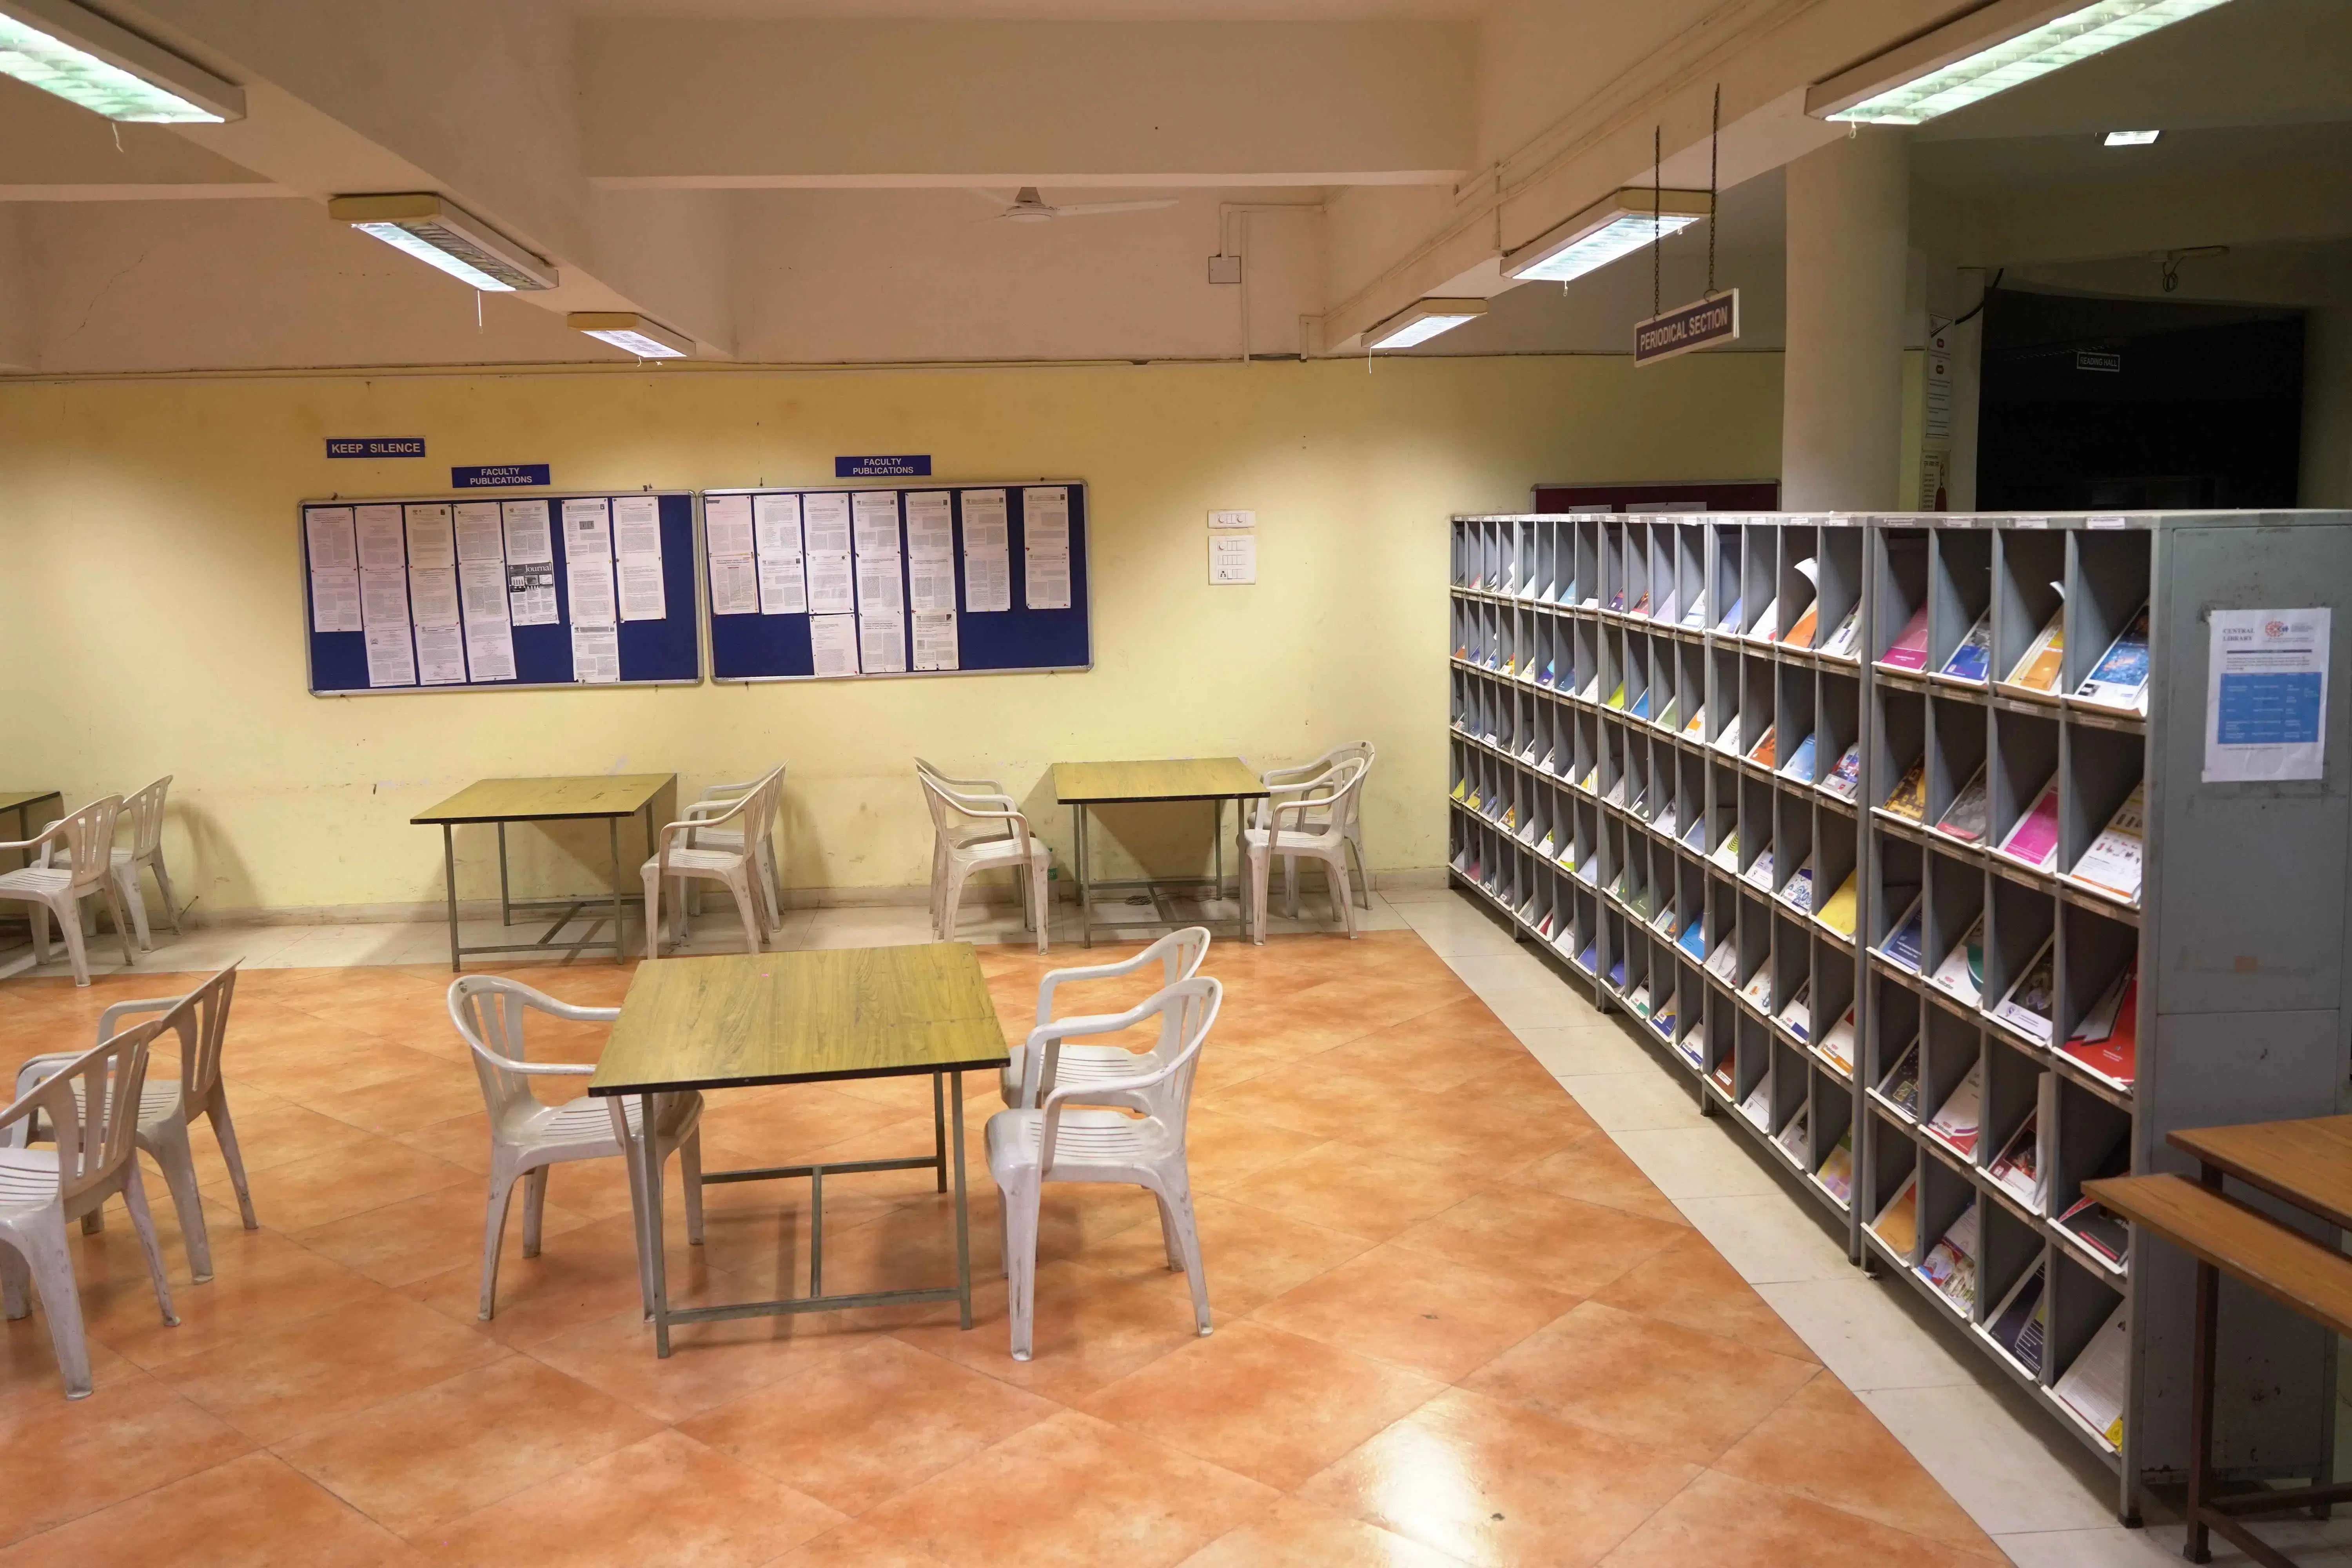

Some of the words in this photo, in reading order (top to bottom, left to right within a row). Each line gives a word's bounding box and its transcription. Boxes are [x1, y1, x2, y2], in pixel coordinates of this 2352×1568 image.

[1641, 320, 1687, 352] PERIODICAL
[1689, 306, 1728, 336] SECTION
[2080, 357, 2103, 365] READING
[331, 444, 363, 453] KEEP
[370, 443, 421, 453] SILENCE
[853, 466, 914, 475] PUBLICATIONS
[470, 476, 532, 485] PUBLICATIONS
[524, 563, 552, 573] Journal
